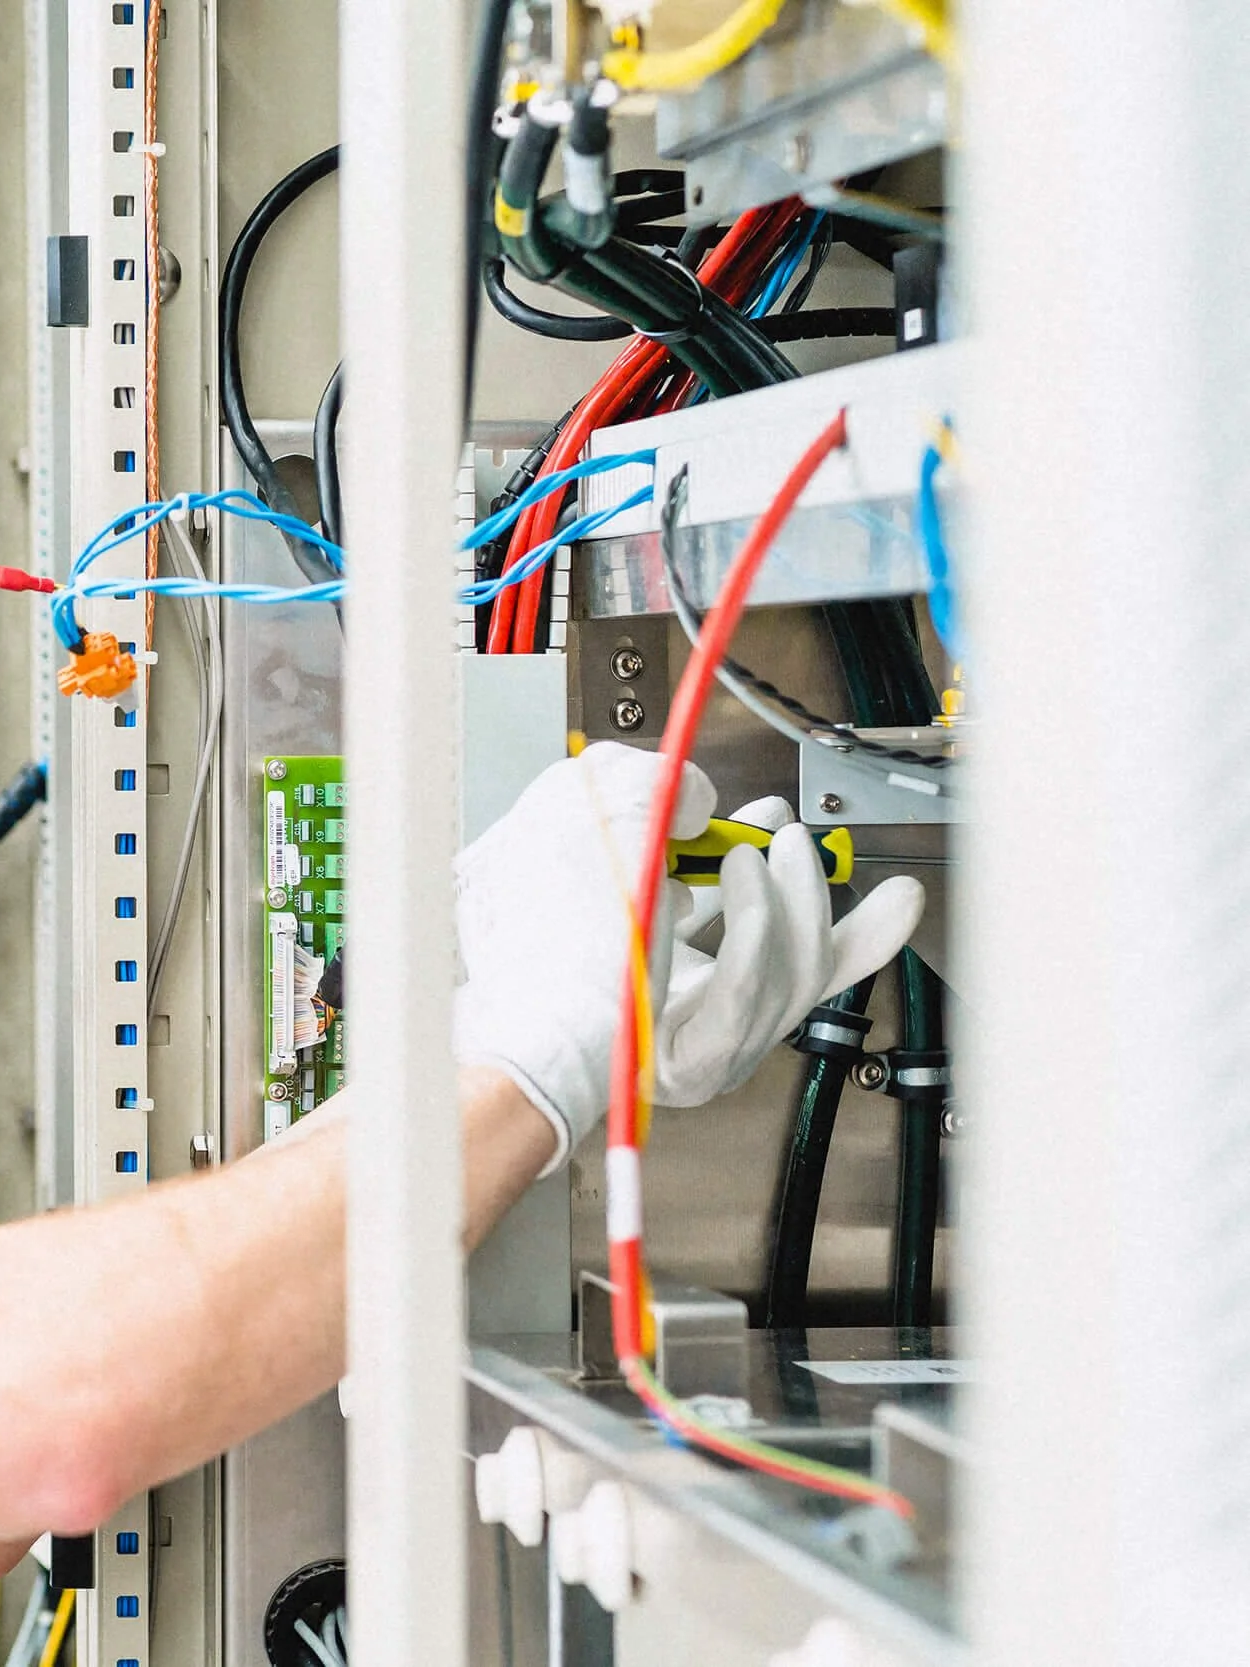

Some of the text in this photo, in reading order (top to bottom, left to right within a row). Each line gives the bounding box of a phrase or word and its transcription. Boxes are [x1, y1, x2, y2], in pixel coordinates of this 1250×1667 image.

[316, 788, 325, 808] X10
[316, 830, 325, 843] X9
[316, 866, 325, 879] X8
[316, 902, 325, 915] X7
